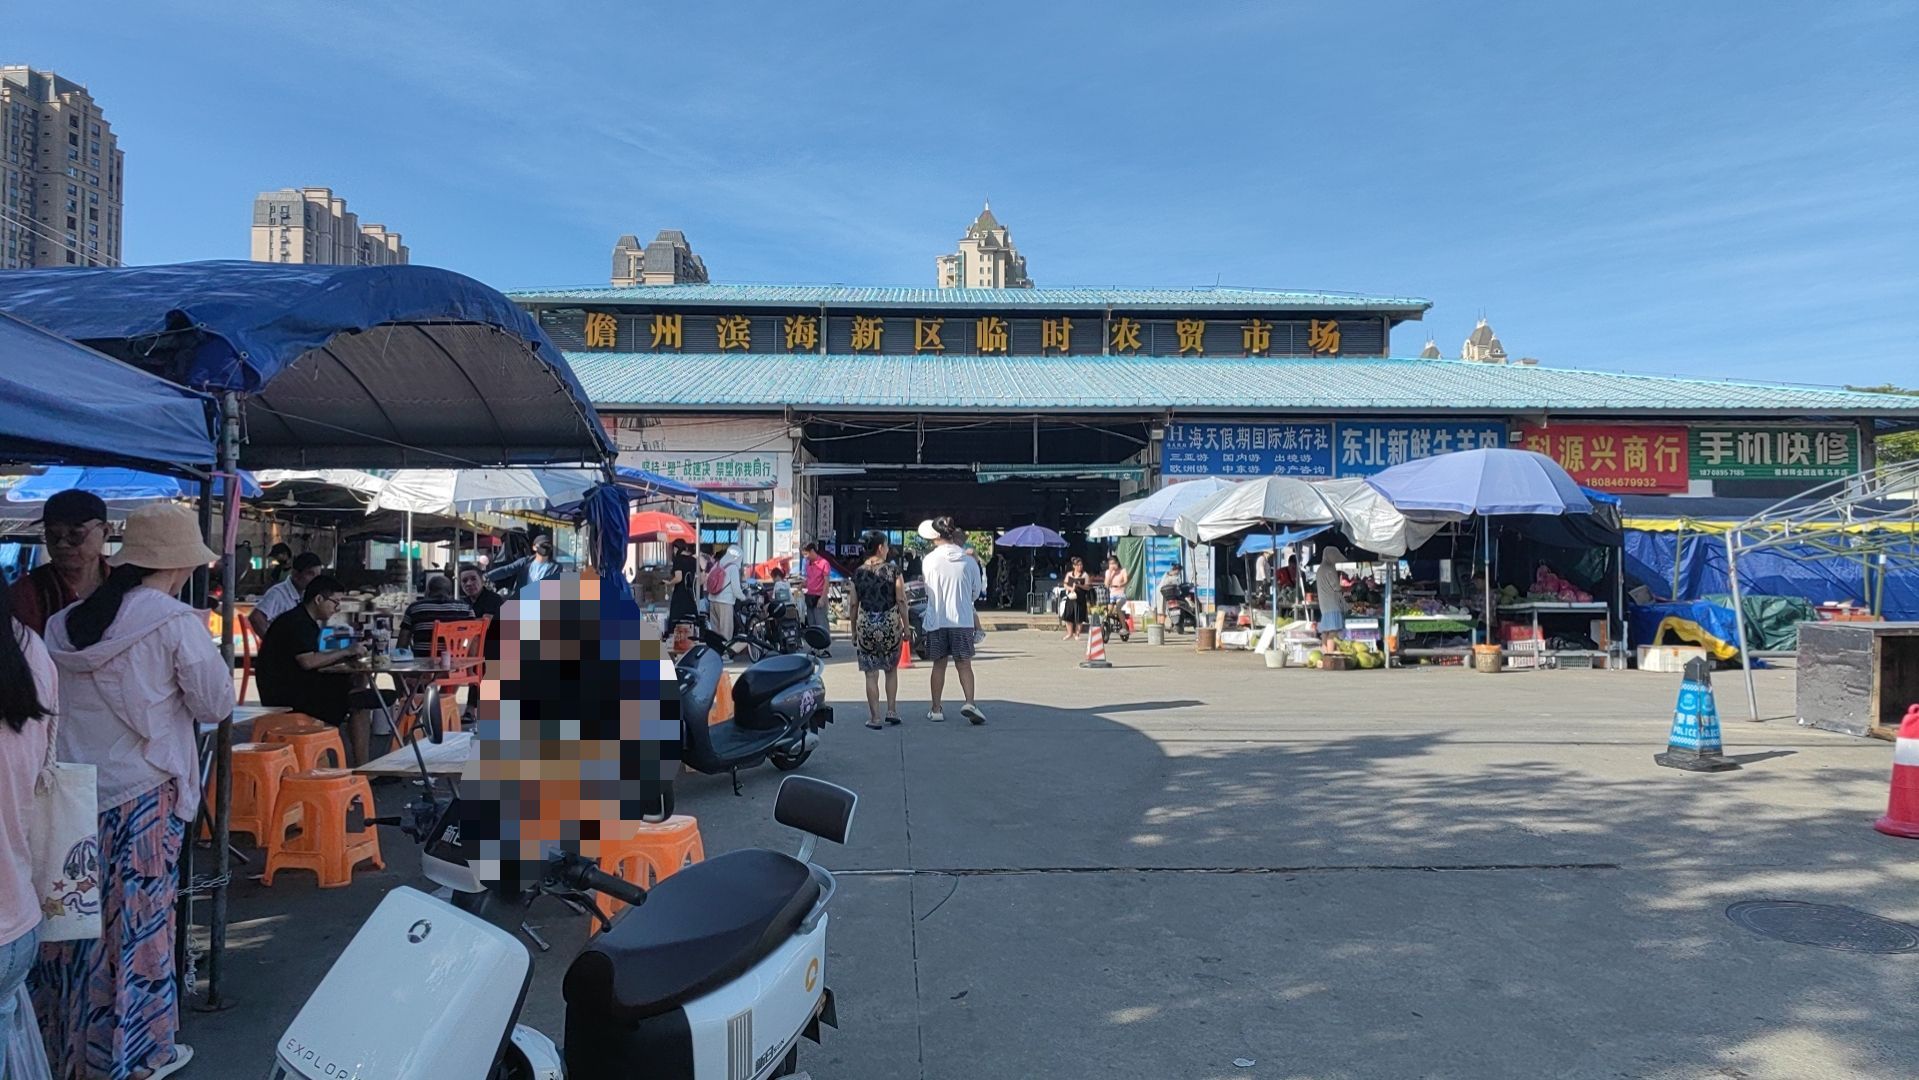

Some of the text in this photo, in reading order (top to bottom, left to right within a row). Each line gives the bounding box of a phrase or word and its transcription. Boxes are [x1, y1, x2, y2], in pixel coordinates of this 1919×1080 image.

[585, 312, 1341, 353] 儋州滨海新区临时农贸市场
[1189, 426, 1329, 450] 海天假期国际旅行社
[1700, 431, 1849, 465] 手机快修
[1169, 453, 1313, 463] 三亚游 国内游 出境游
[1169, 464, 1325, 475] 欧洲游 中东游 房产咨询
[1585, 478, 1657, 487] 18084679932
[1673, 725, 1697, 738] POLICE
[286, 1038, 354, 1080] EXPLOR
